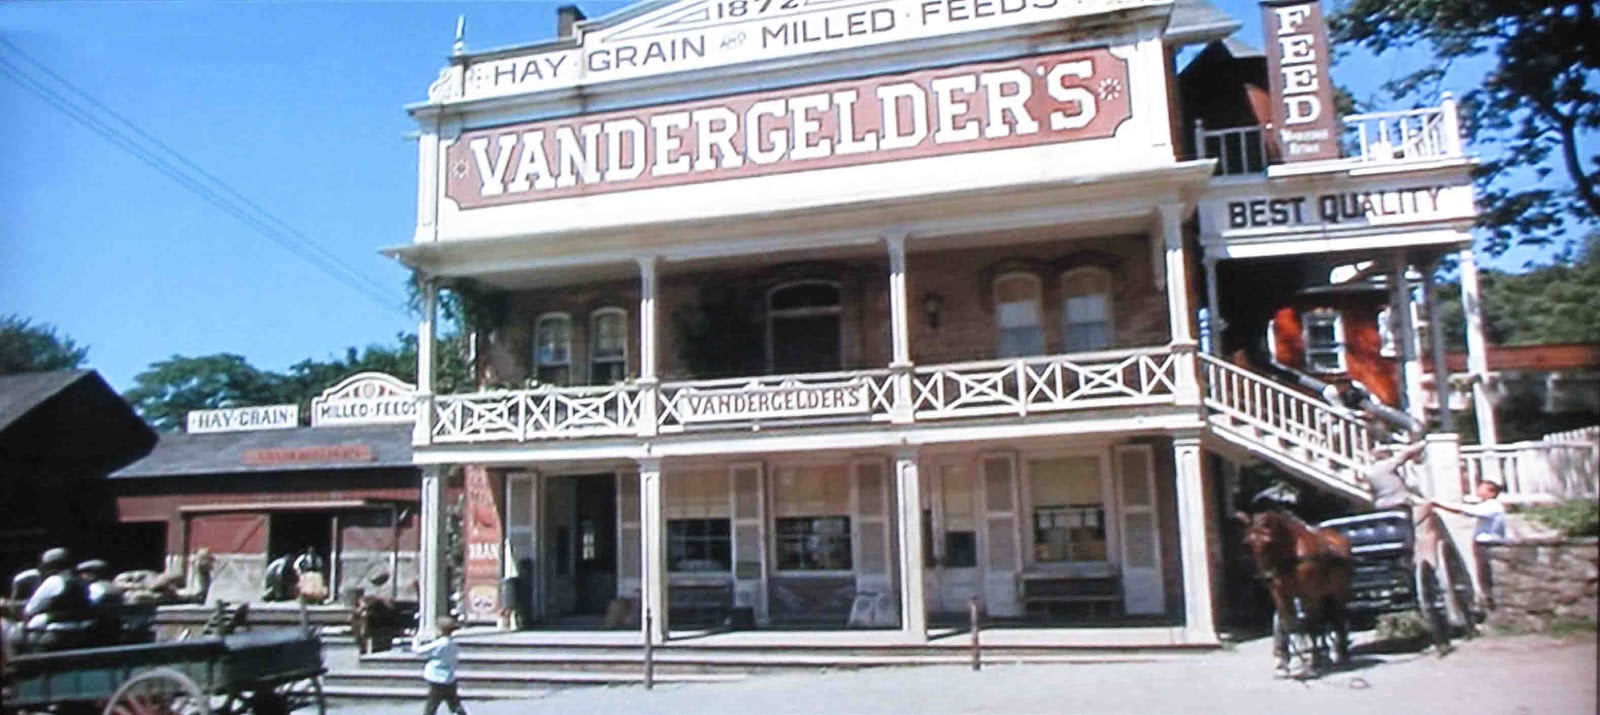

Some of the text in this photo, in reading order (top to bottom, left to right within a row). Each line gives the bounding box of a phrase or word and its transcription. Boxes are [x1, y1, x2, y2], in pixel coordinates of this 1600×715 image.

[494, 55, 567, 86] HAY
[588, 35, 706, 73] GRAIN
[761, 8, 896, 49] MILLED
[1275, 5, 1323, 125] FEED
[469, 59, 1098, 197] VANDERGELDER'S
[1229, 186, 1443, 228] BEST QUALITY
[198, 410, 235, 429] HAY
